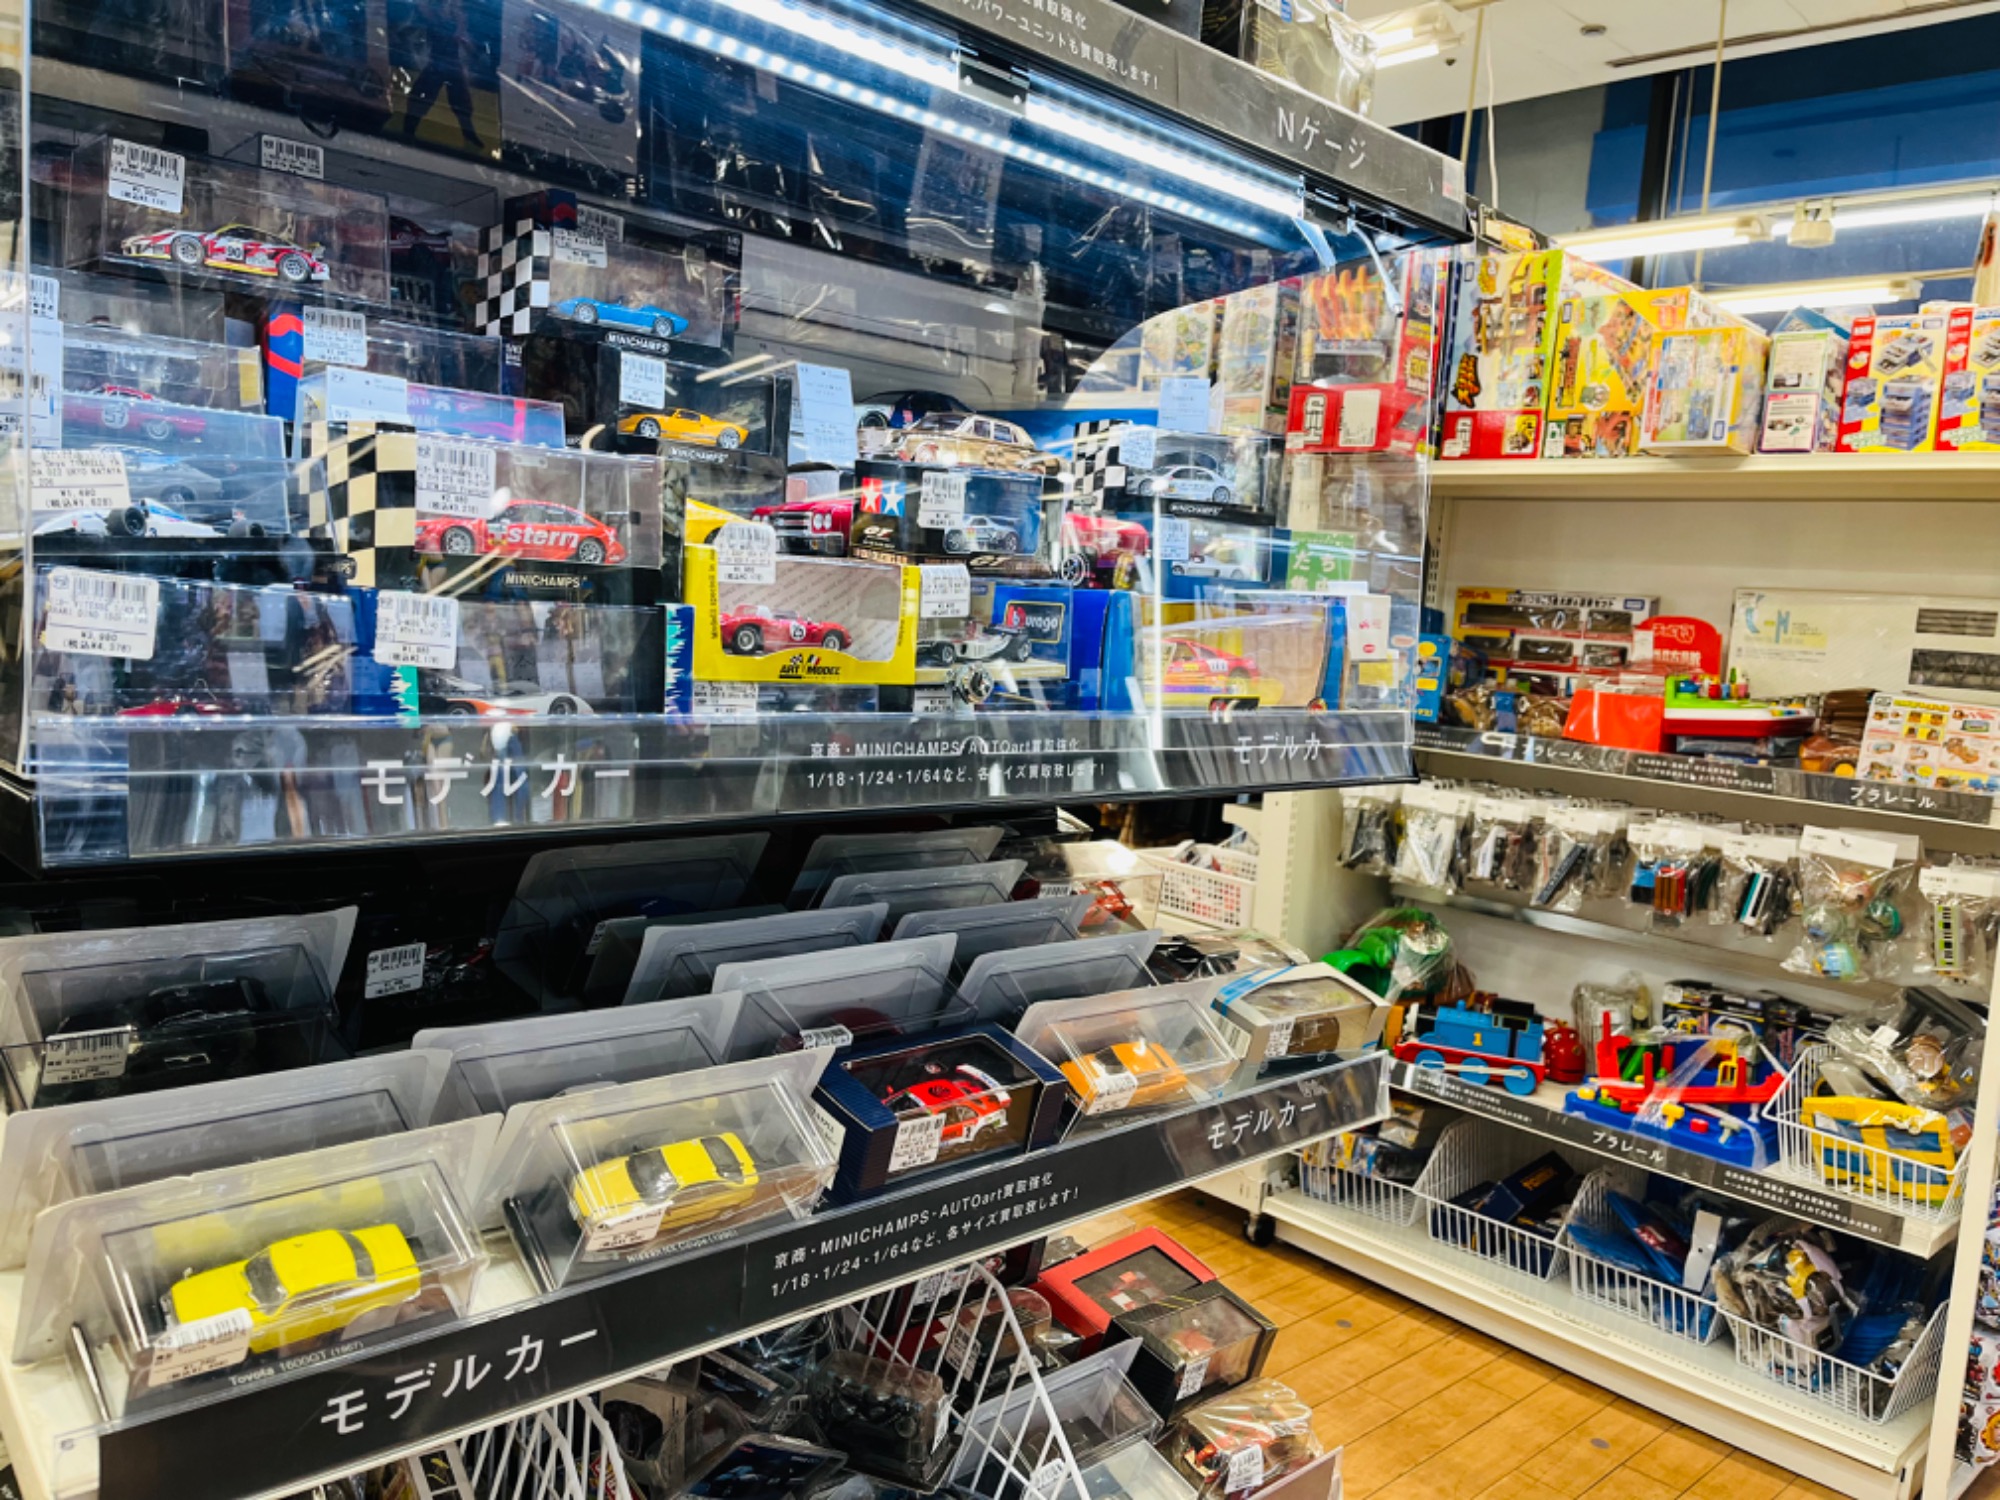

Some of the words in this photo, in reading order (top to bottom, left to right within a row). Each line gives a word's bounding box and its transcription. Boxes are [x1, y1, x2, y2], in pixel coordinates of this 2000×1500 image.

[1277, 106, 1367, 170] Nゲージ
[607, 331, 670, 352] MINICHAMPS
[507, 526, 579, 549] stern
[505, 572, 581, 588] MINICHAMPS
[779, 664, 800, 674] ART
[806, 665, 841, 675] MODEL
[361, 753, 630, 806] モデルカー
[1850, 785, 1936, 810] プラレール
[1207, 1098, 1317, 1151] モデルカー
[1593, 1130, 1664, 1162] プラレール
[229, 1366, 275, 1386] Toyota
[320, 1328, 598, 1436] モデルカー
